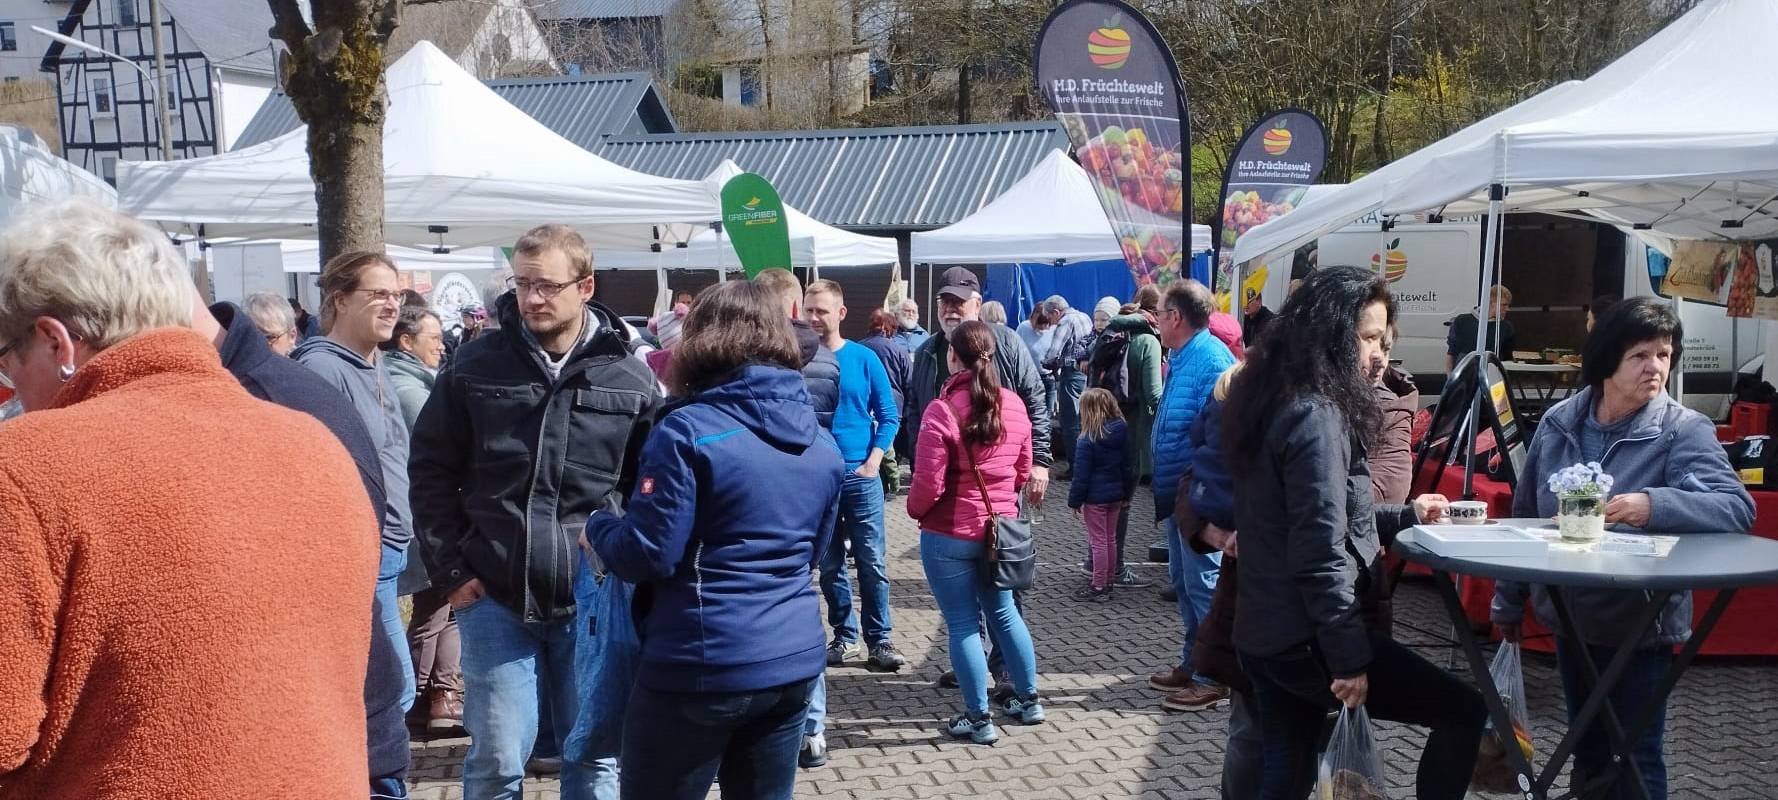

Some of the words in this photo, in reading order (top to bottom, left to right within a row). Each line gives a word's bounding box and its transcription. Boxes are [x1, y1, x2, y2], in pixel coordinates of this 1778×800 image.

[1082, 78, 1164, 95] Früchtewelt
[1056, 95, 1070, 104] Ihre
[1072, 94, 1120, 104] Anlaufstelle
[1121, 96, 1133, 105] zur
[1135, 96, 1163, 107] Frische
[1257, 160, 1311, 172] Früchtewelt
[728, 210, 776, 221] GREENFIBER
